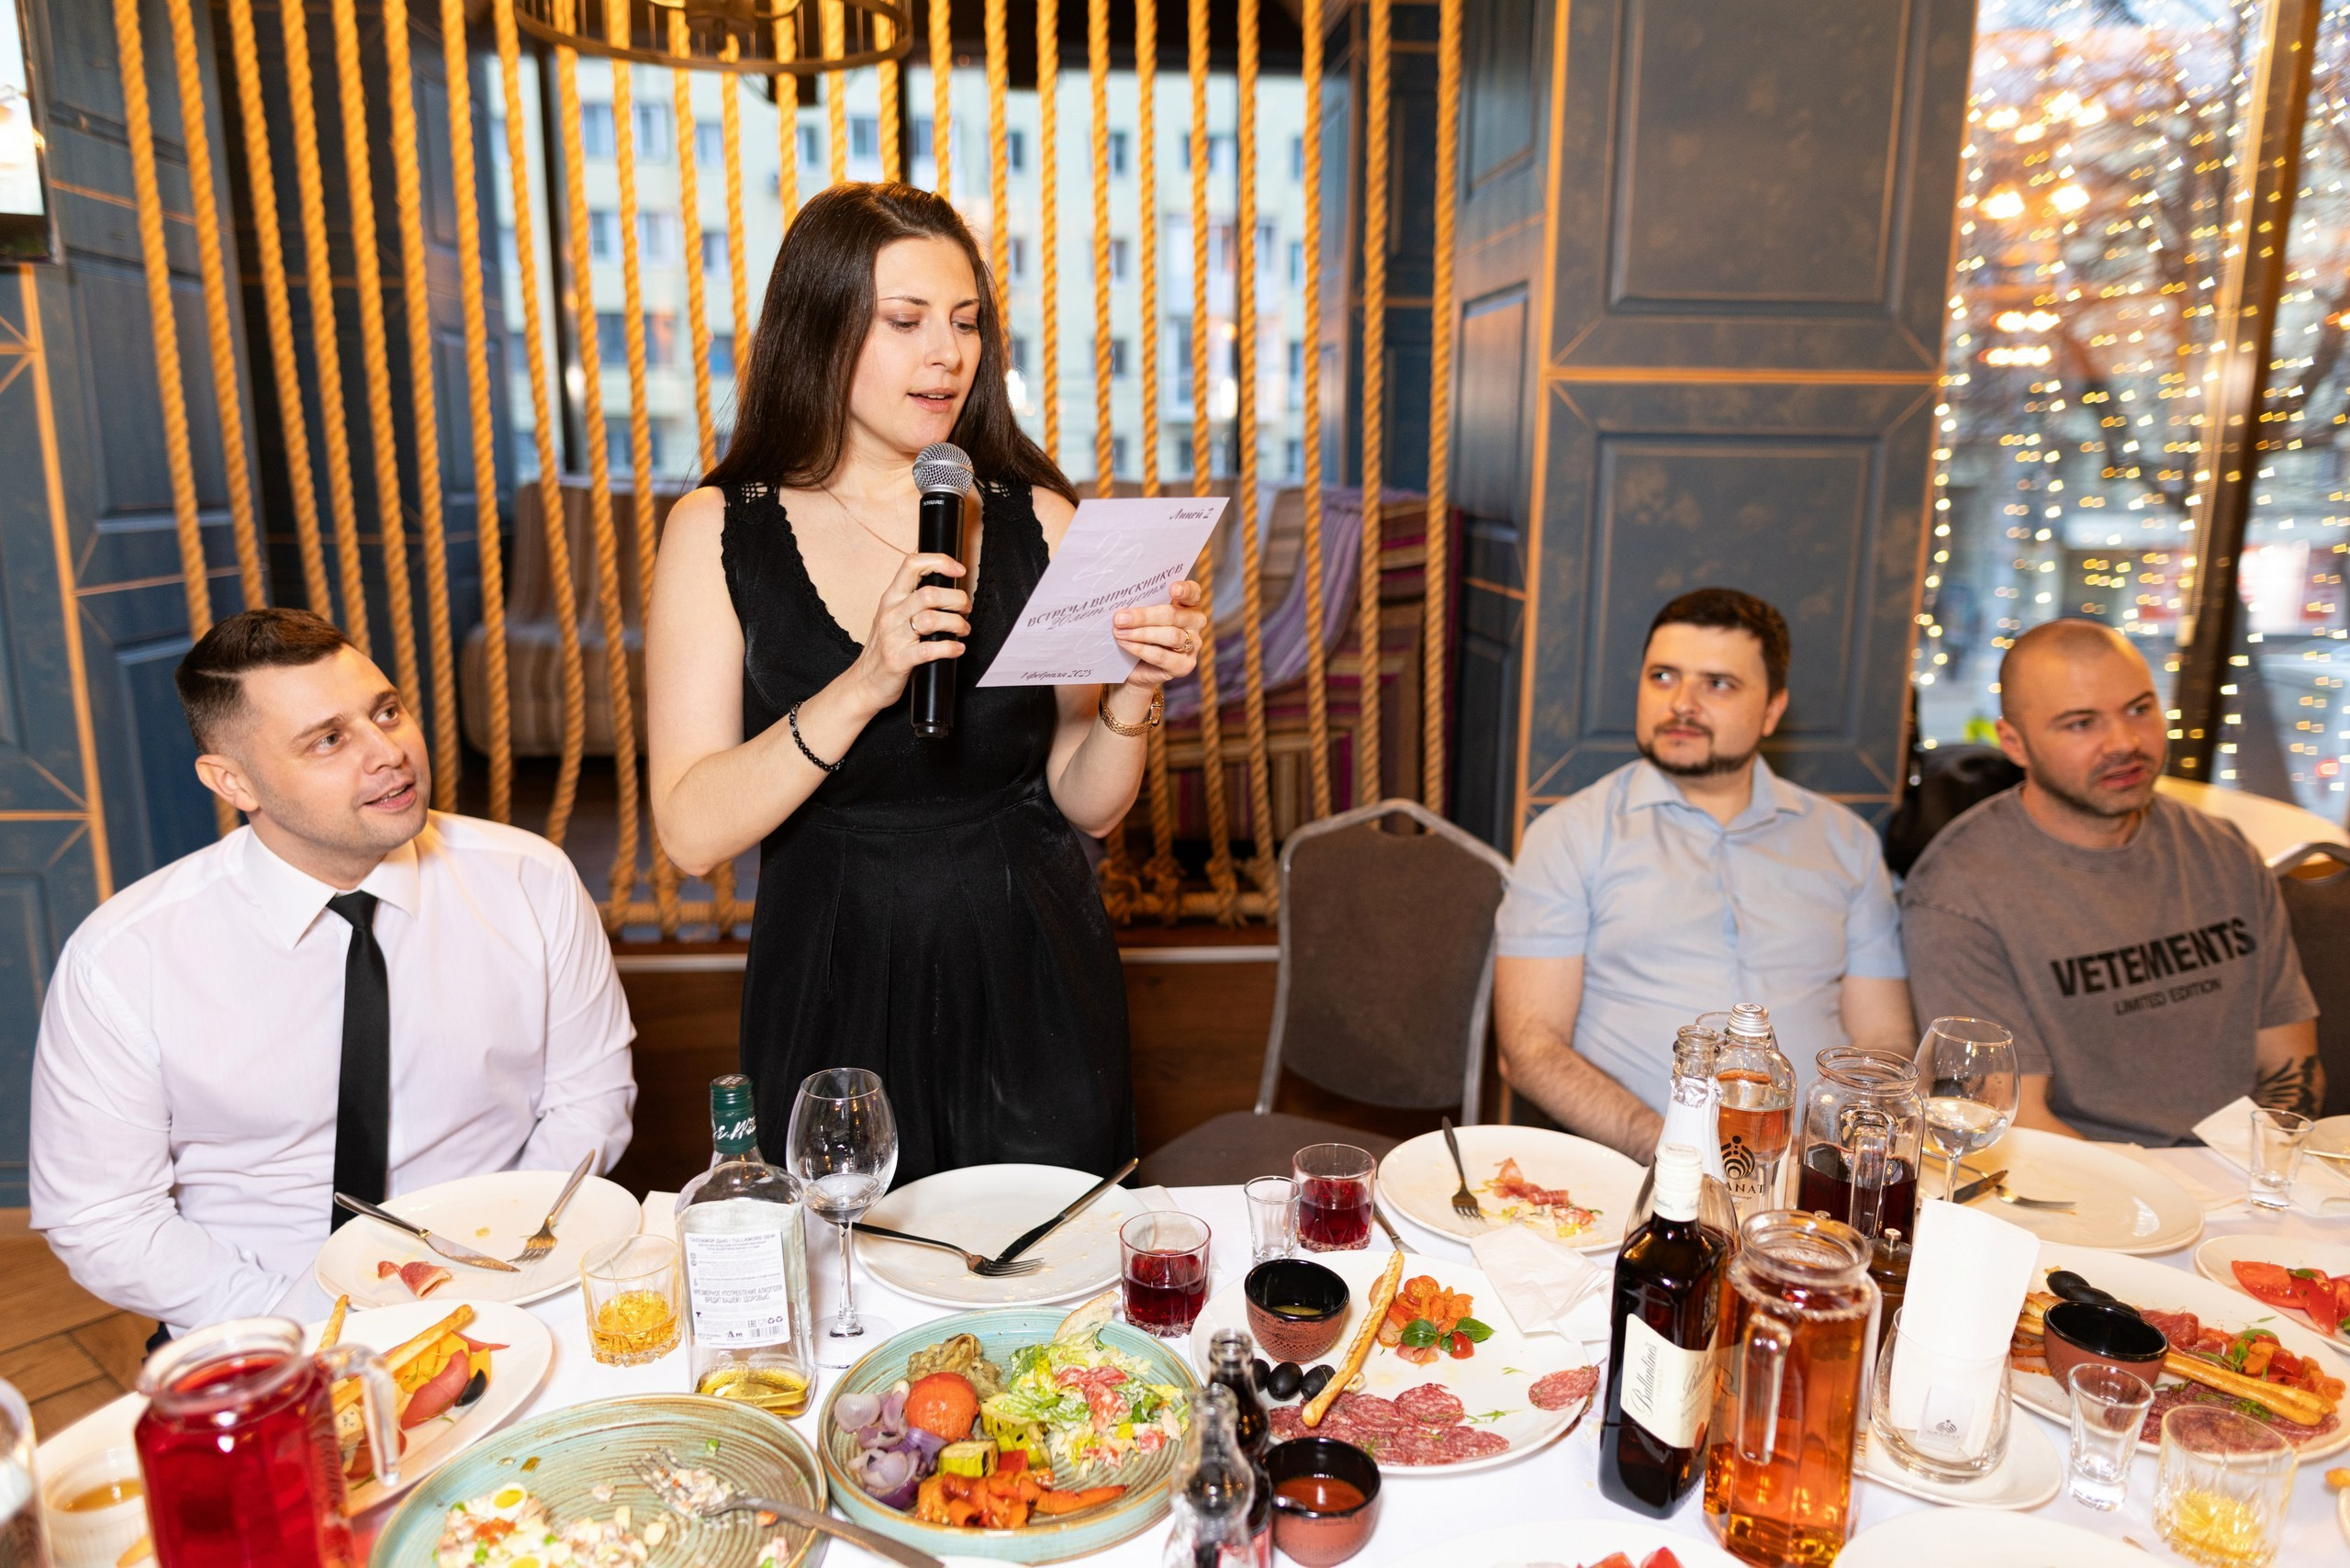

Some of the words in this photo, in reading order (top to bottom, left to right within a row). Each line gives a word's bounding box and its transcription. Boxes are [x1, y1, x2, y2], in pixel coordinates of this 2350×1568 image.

[1203, 508, 1214, 519] 2
[1027, 601, 1088, 628] ВСТРЕЧА
[1091, 563, 1184, 607] ВЫПУСКНИКОВ
[2050, 917, 2257, 998] VETEMENTS
[2115, 991, 2167, 1016] LIMITED
[2170, 978, 2223, 1003] EDITION
